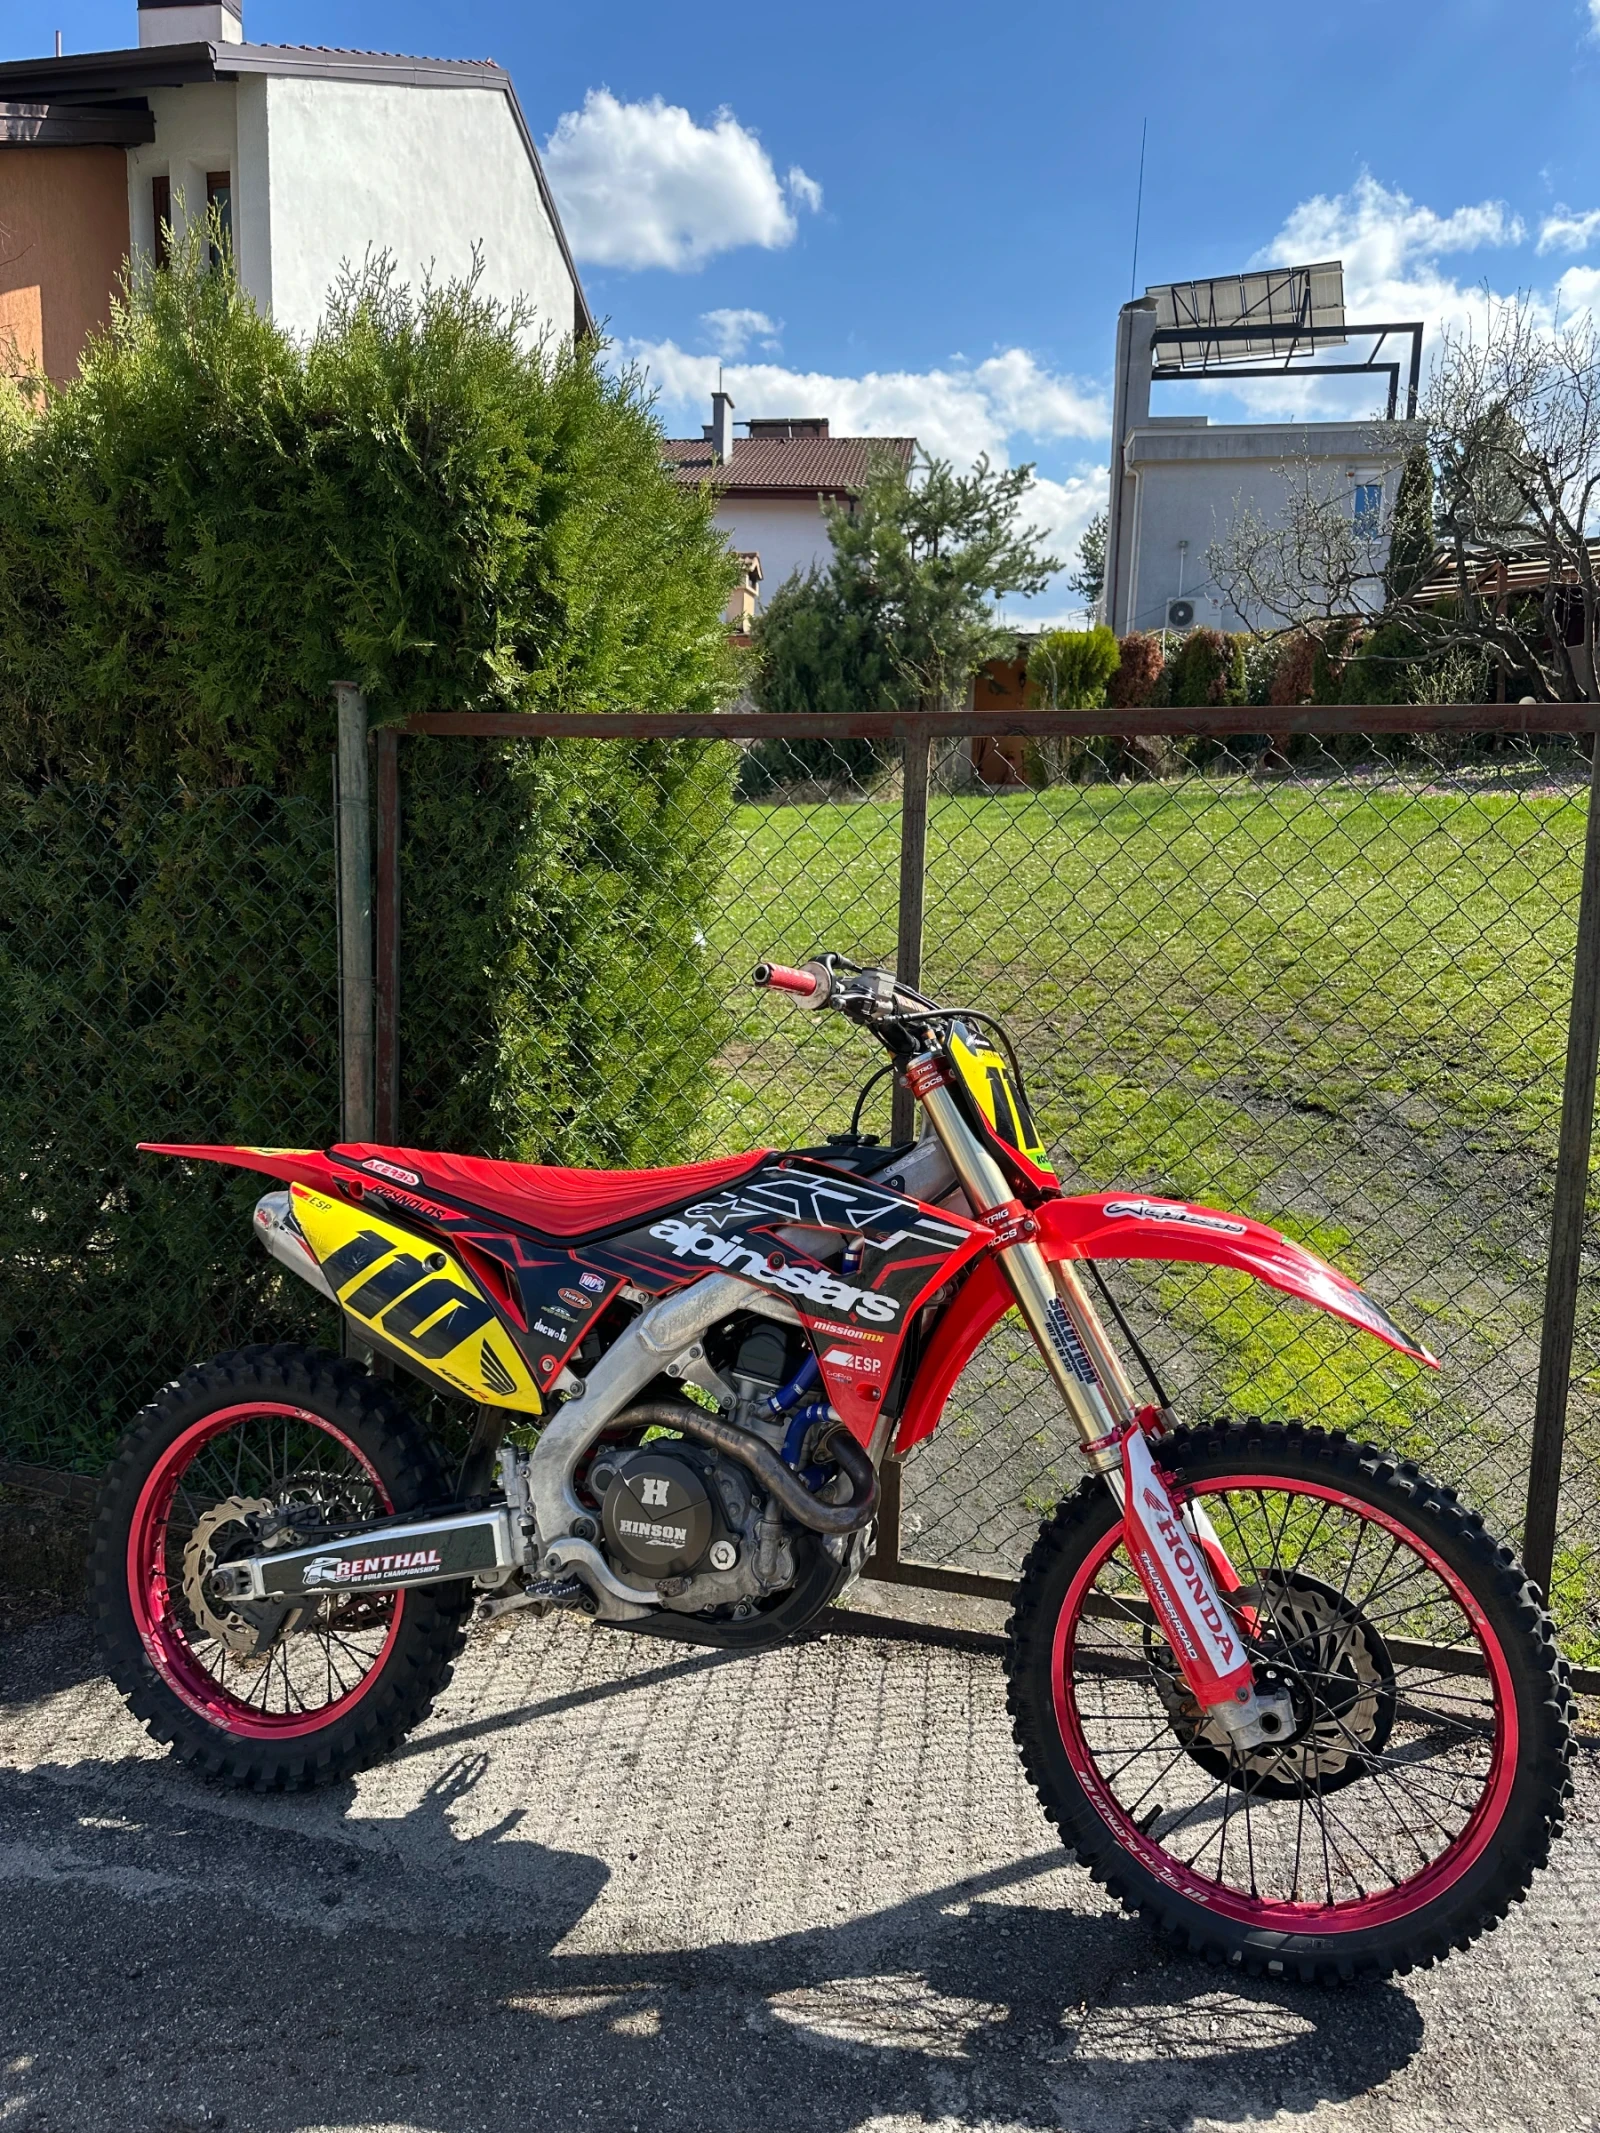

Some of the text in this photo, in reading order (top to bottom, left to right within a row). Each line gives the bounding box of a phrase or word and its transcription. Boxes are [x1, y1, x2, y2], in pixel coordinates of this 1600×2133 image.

[649, 1219, 900, 1322] alpinestars
[813, 1321, 885, 1343] missionmx
[1048, 1297, 1098, 1385] SOLUTION
[619, 1519, 687, 1541] HINSON
[336, 1549, 442, 1576] RENTHAL
[363, 1571, 381, 1581] BUILD
[383, 1564, 441, 1579] CHAMPIONSHIPS
[1156, 1515, 1235, 1666] HONDA
